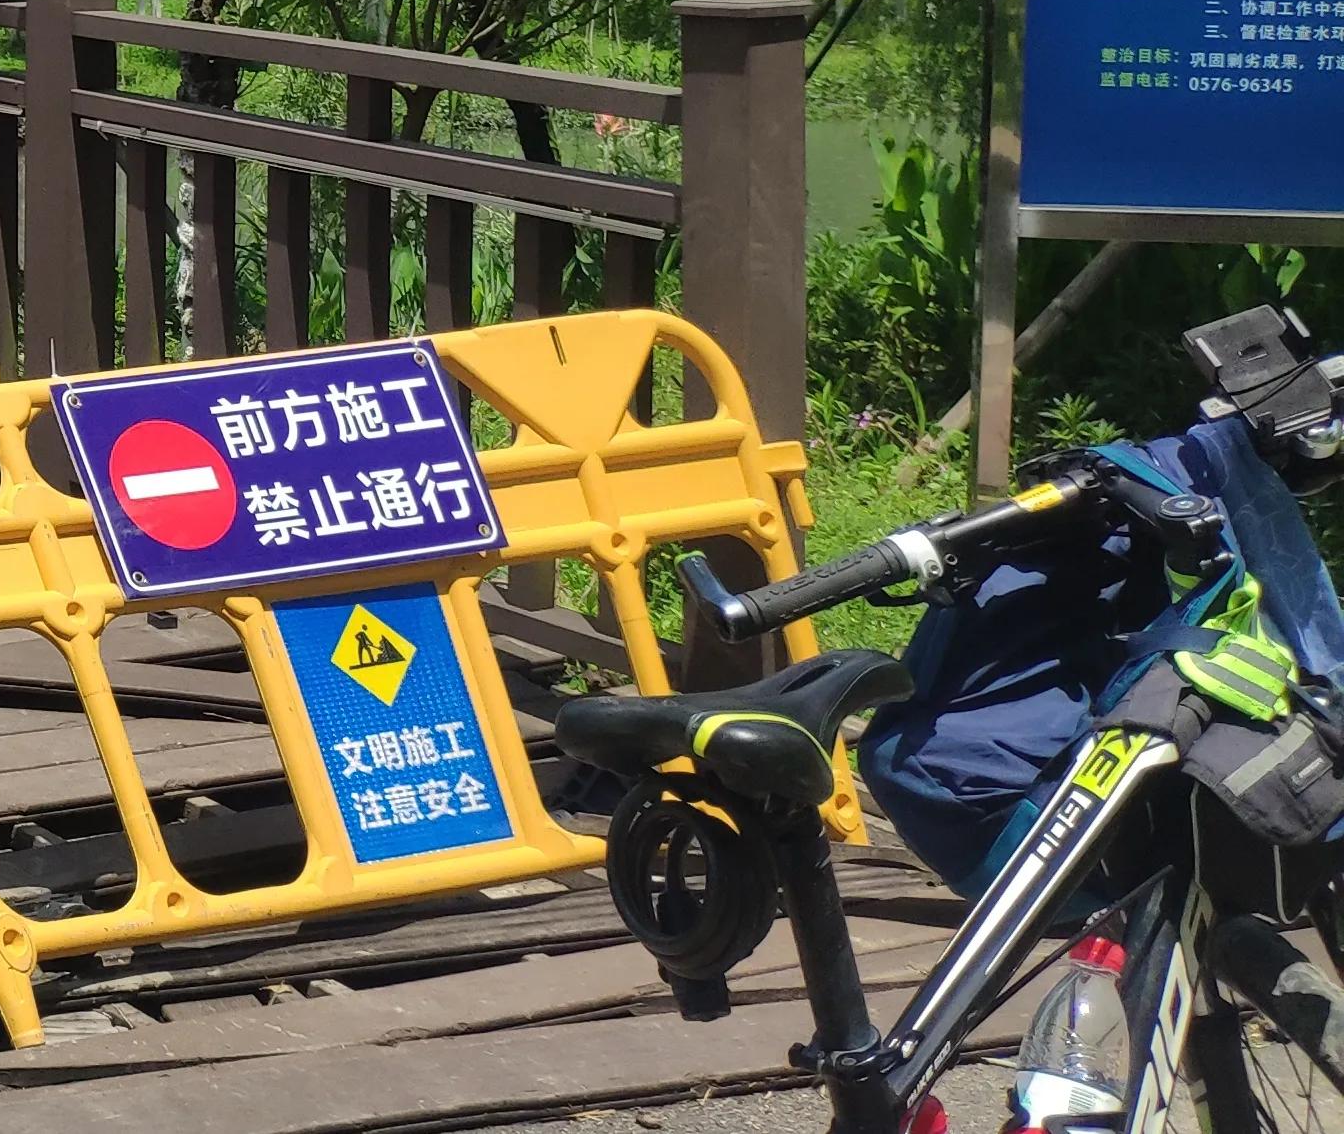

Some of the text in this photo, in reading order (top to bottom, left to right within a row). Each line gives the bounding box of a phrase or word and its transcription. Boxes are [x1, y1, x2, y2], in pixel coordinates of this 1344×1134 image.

[1187, 76, 1294, 94] 0576-96345
[210, 375, 446, 459] 前方施工
[243, 461, 471, 547] 禁止通行
[333, 720, 475, 779] 文明施工
[351, 771, 493, 832] 注意安全
